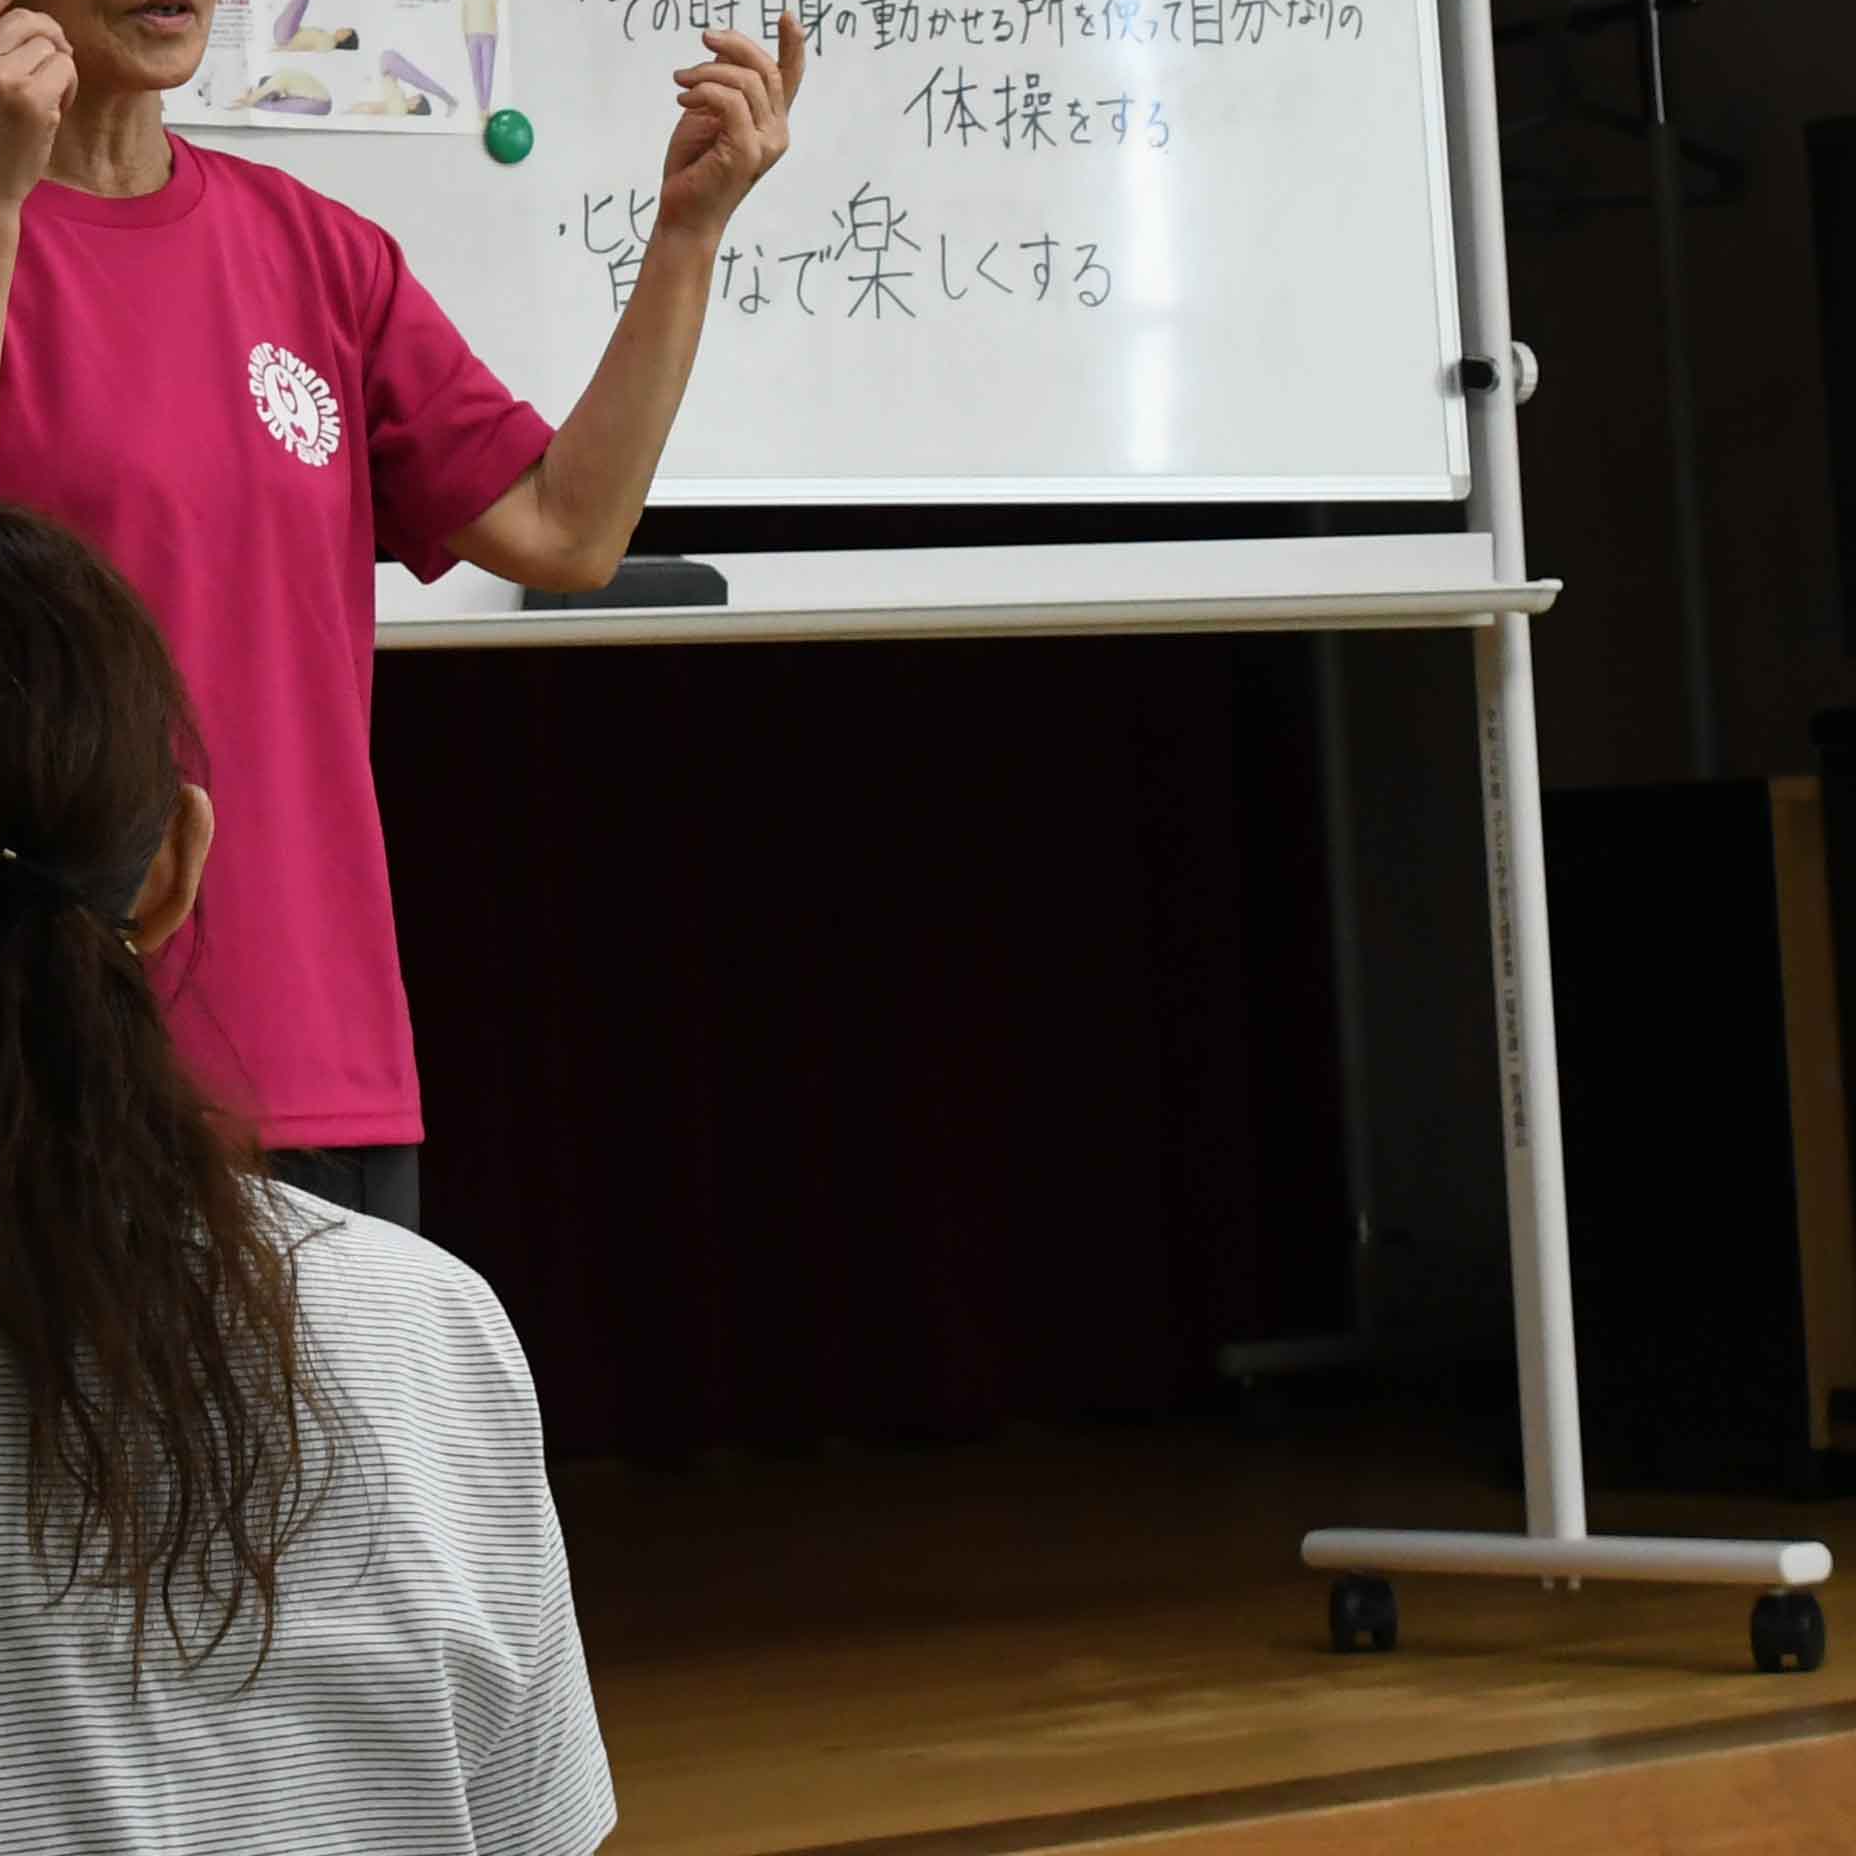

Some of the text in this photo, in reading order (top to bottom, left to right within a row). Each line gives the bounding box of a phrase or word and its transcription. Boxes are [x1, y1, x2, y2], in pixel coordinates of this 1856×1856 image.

[903, 66, 1171, 150] 体操をする
